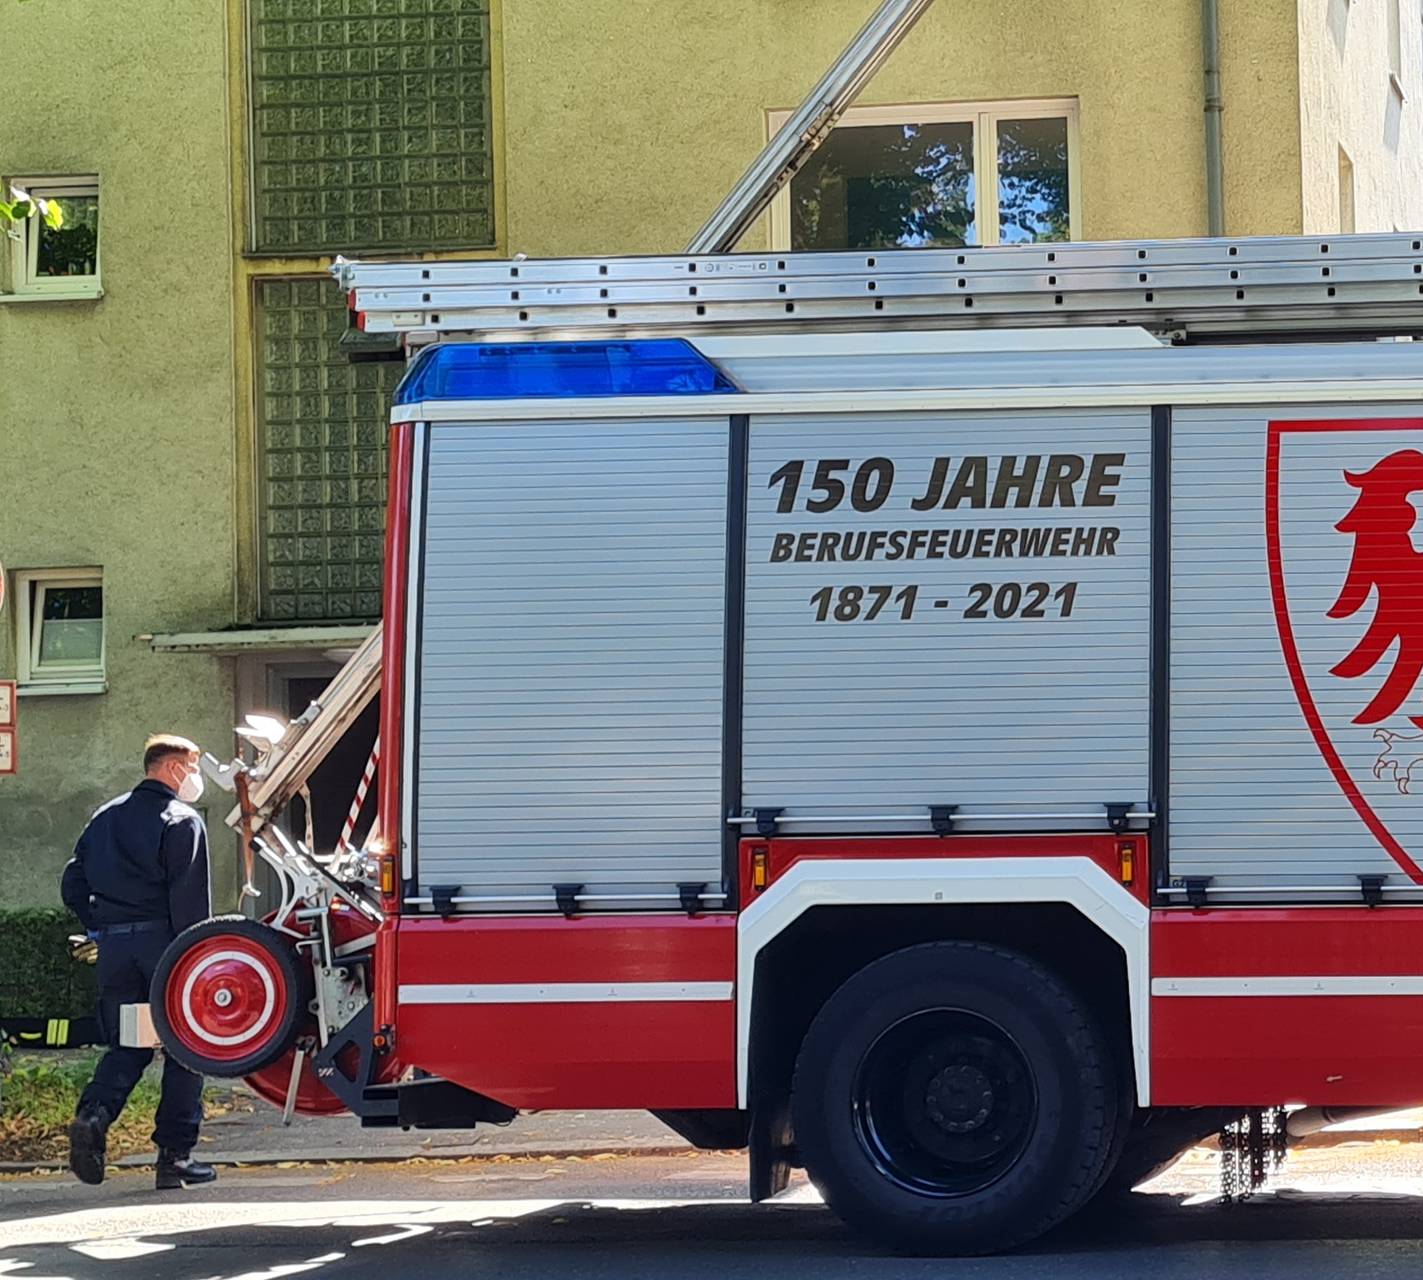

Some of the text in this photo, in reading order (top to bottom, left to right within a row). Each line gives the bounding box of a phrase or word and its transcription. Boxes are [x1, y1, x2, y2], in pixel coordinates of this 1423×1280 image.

[767, 452, 1126, 514] 150 JAHRE
[769, 526, 1121, 563] BERUFSFEUERWEHR
[809, 584, 919, 622] 1871
[963, 581, 1078, 619] 2021
